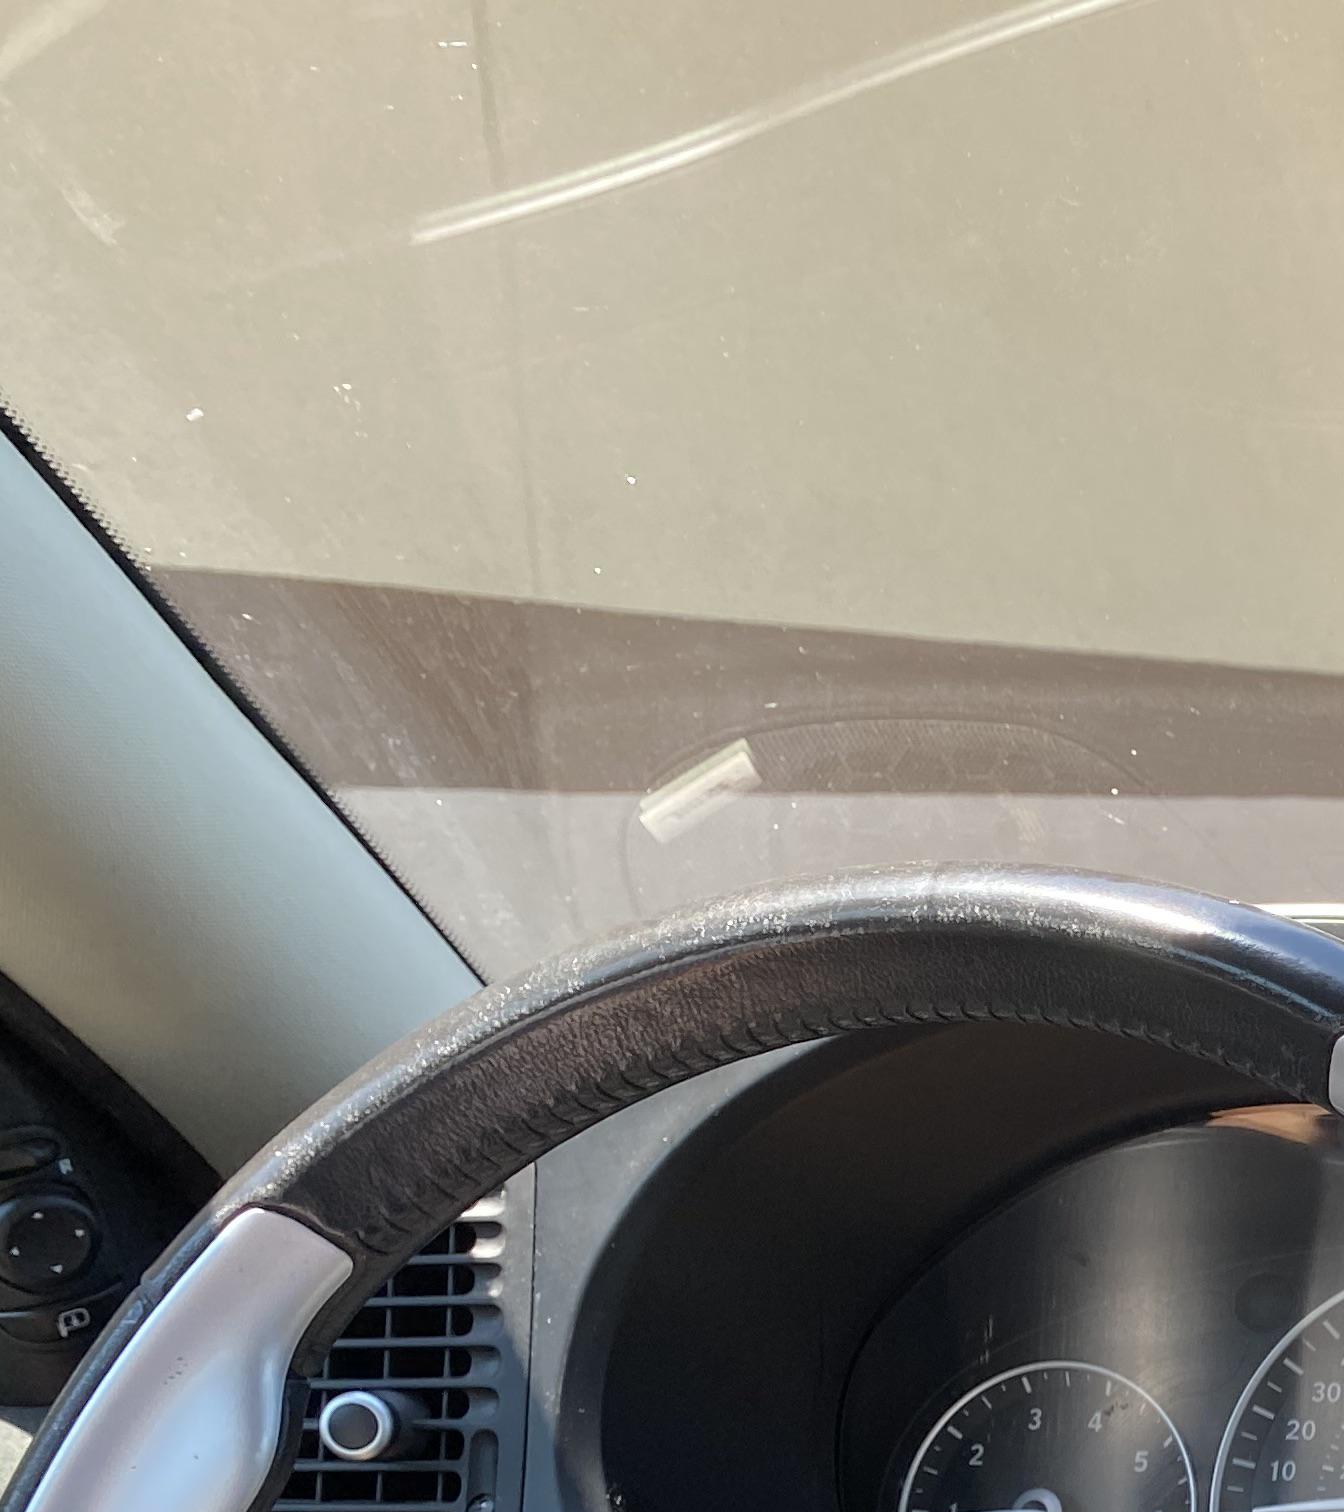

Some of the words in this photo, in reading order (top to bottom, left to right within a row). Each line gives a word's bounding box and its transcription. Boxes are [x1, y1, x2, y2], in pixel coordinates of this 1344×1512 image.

[1312, 1381, 1341, 1403] 30
[1028, 1408, 1042, 1430] 3
[1088, 1411, 1103, 1433] 4
[1285, 1420, 1316, 1441] 20
[969, 1444, 984, 1465] 2
[1134, 1451, 1149, 1472] 5
[1270, 1460, 1296, 1481] 10
